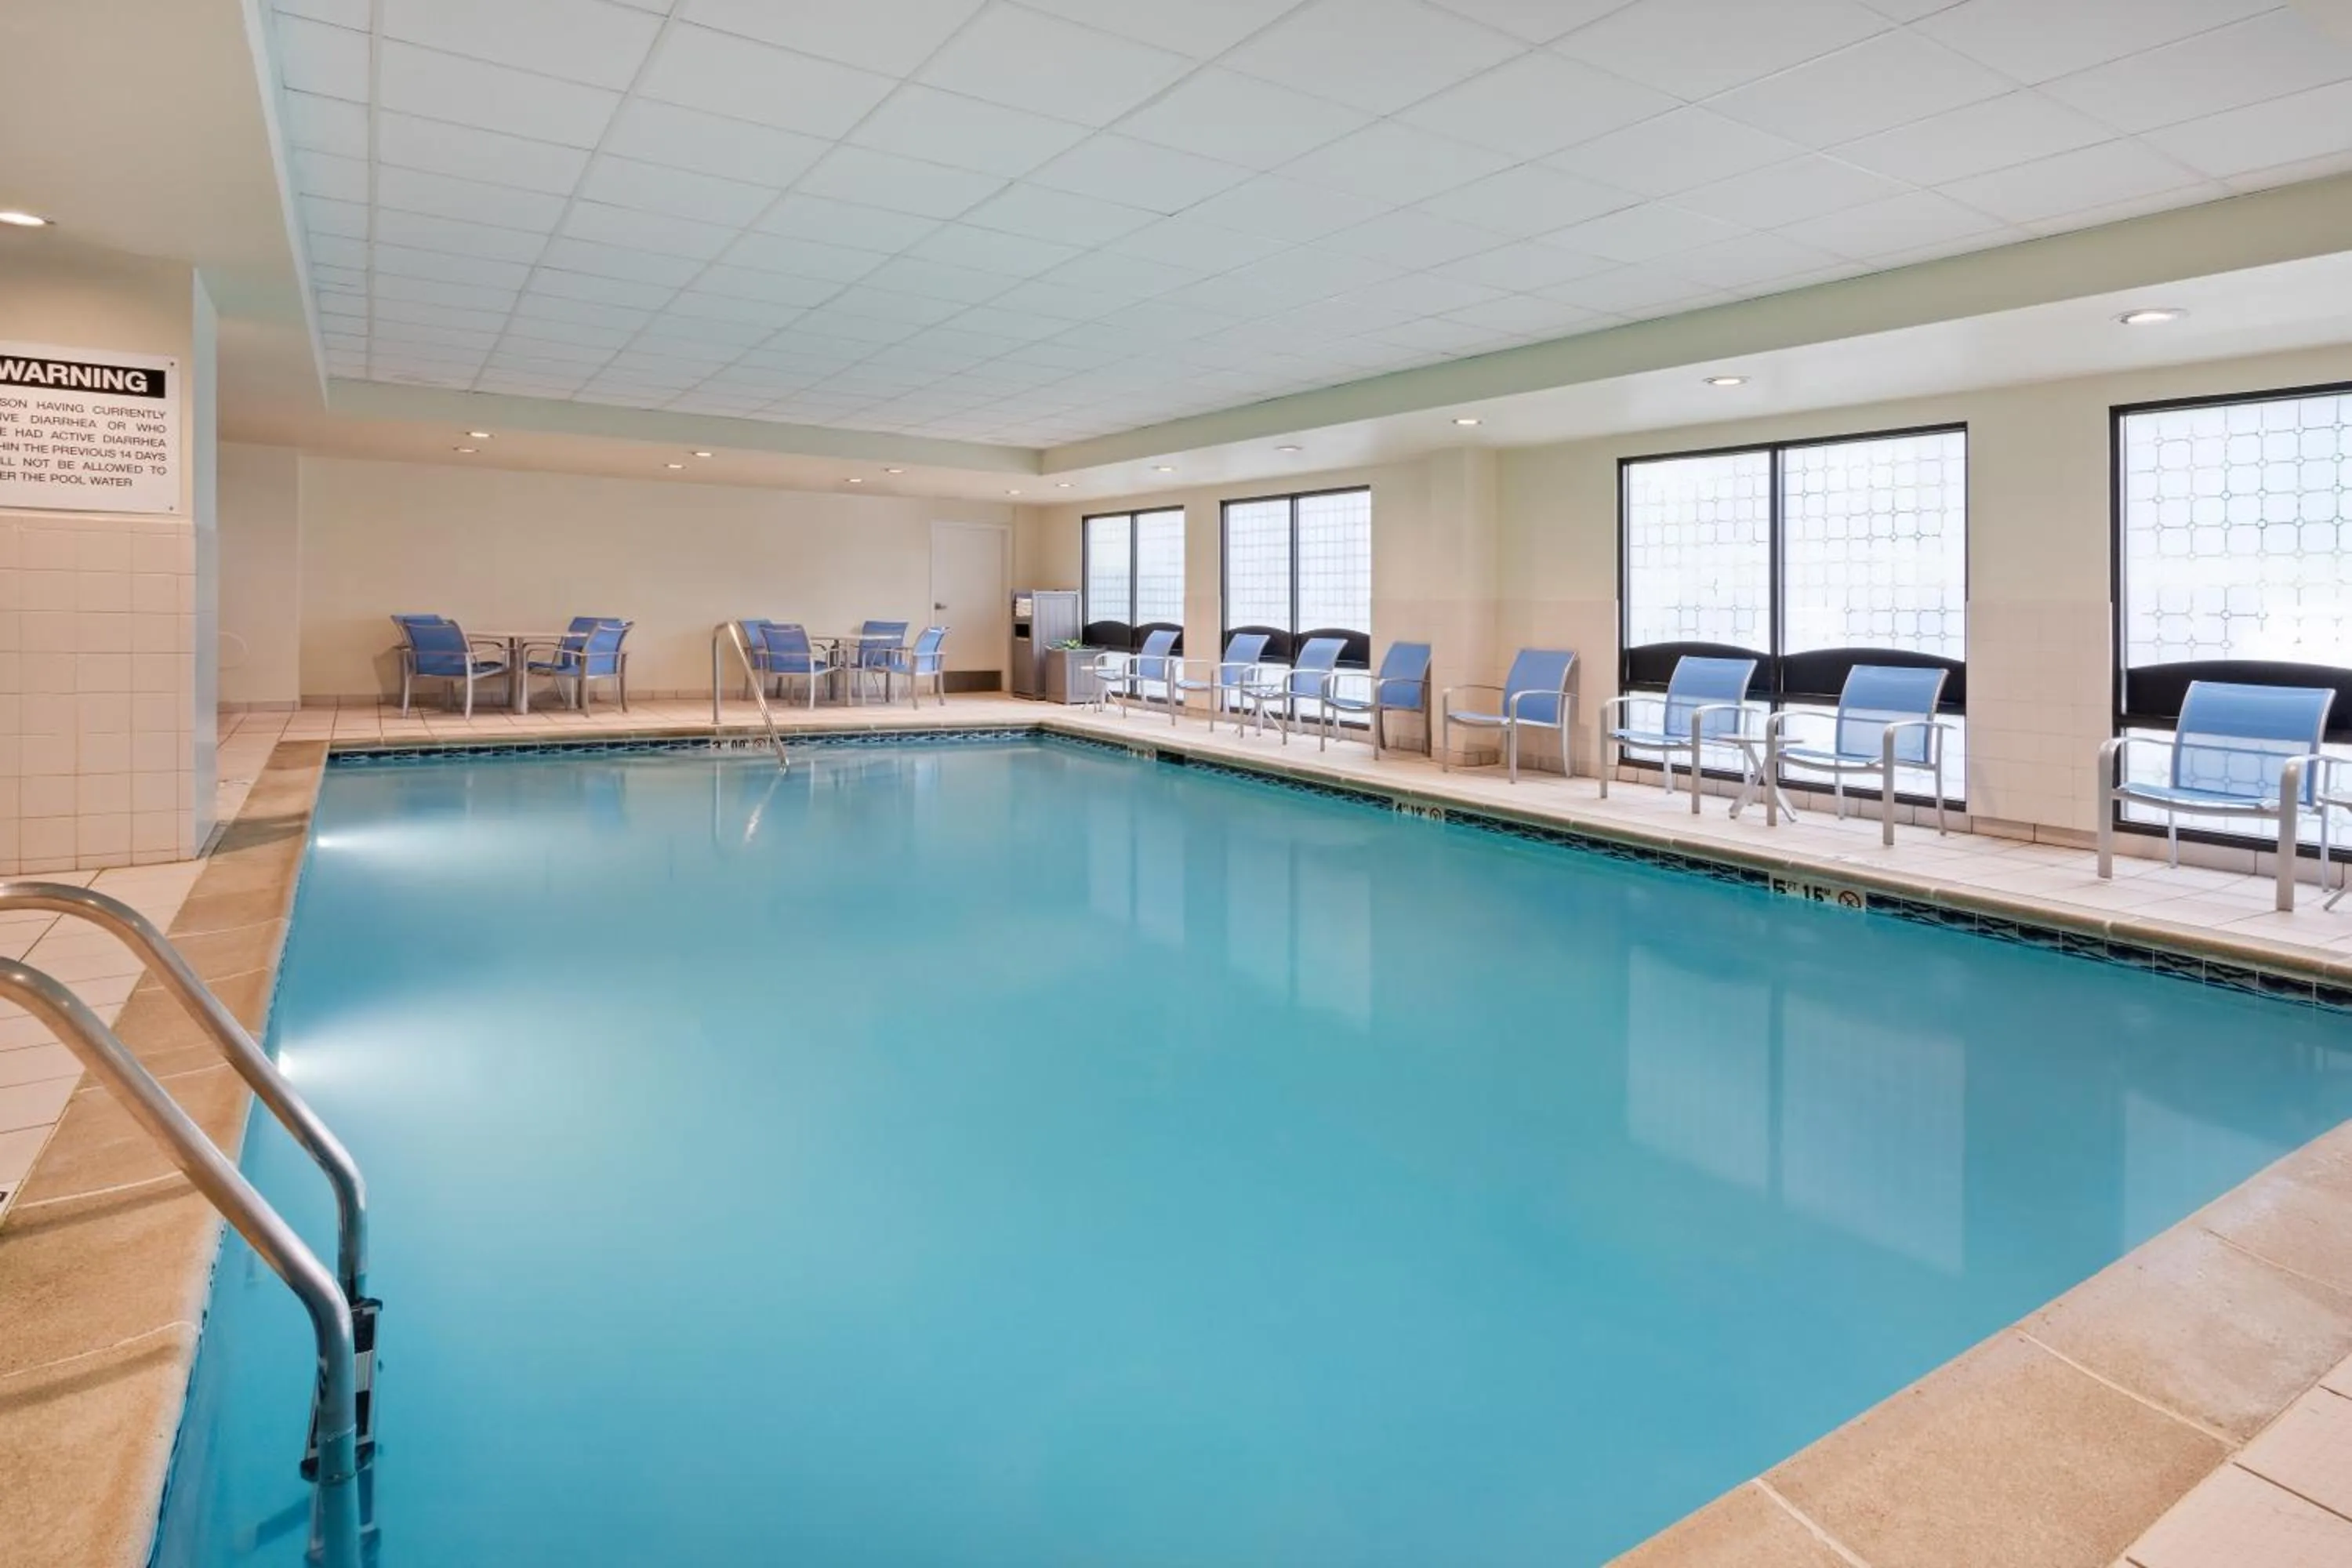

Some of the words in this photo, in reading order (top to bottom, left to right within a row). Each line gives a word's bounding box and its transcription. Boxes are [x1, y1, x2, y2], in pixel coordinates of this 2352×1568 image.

[0, 359, 147, 392] WARNING
[37, 401, 85, 412] HAVING
[93, 405, 165, 419] CURRENTLY
[31, 415, 97, 428] DIARRHEA
[108, 421, 126, 430] OR
[136, 423, 167, 434] WHO
[15, 427, 43, 438] HAD
[50, 430, 95, 443] ACTIVE
[103, 434, 166, 448] DIARRHEA
[24, 443, 49, 453] THE
[53, 445, 117, 459] PREVIOUS
[120, 450, 132, 459] 14
[135, 451, 167, 462] DAYS
[23, 457, 50, 468] NOT
[57, 459, 75, 470] BE
[82, 462, 143, 474] ALLOWED
[150, 465, 167, 476] TO
[0, 471, 16, 481] ER
[20, 471, 45, 481] THE
[49, 473, 86, 485] POOL
[89, 476, 132, 487] WATER
